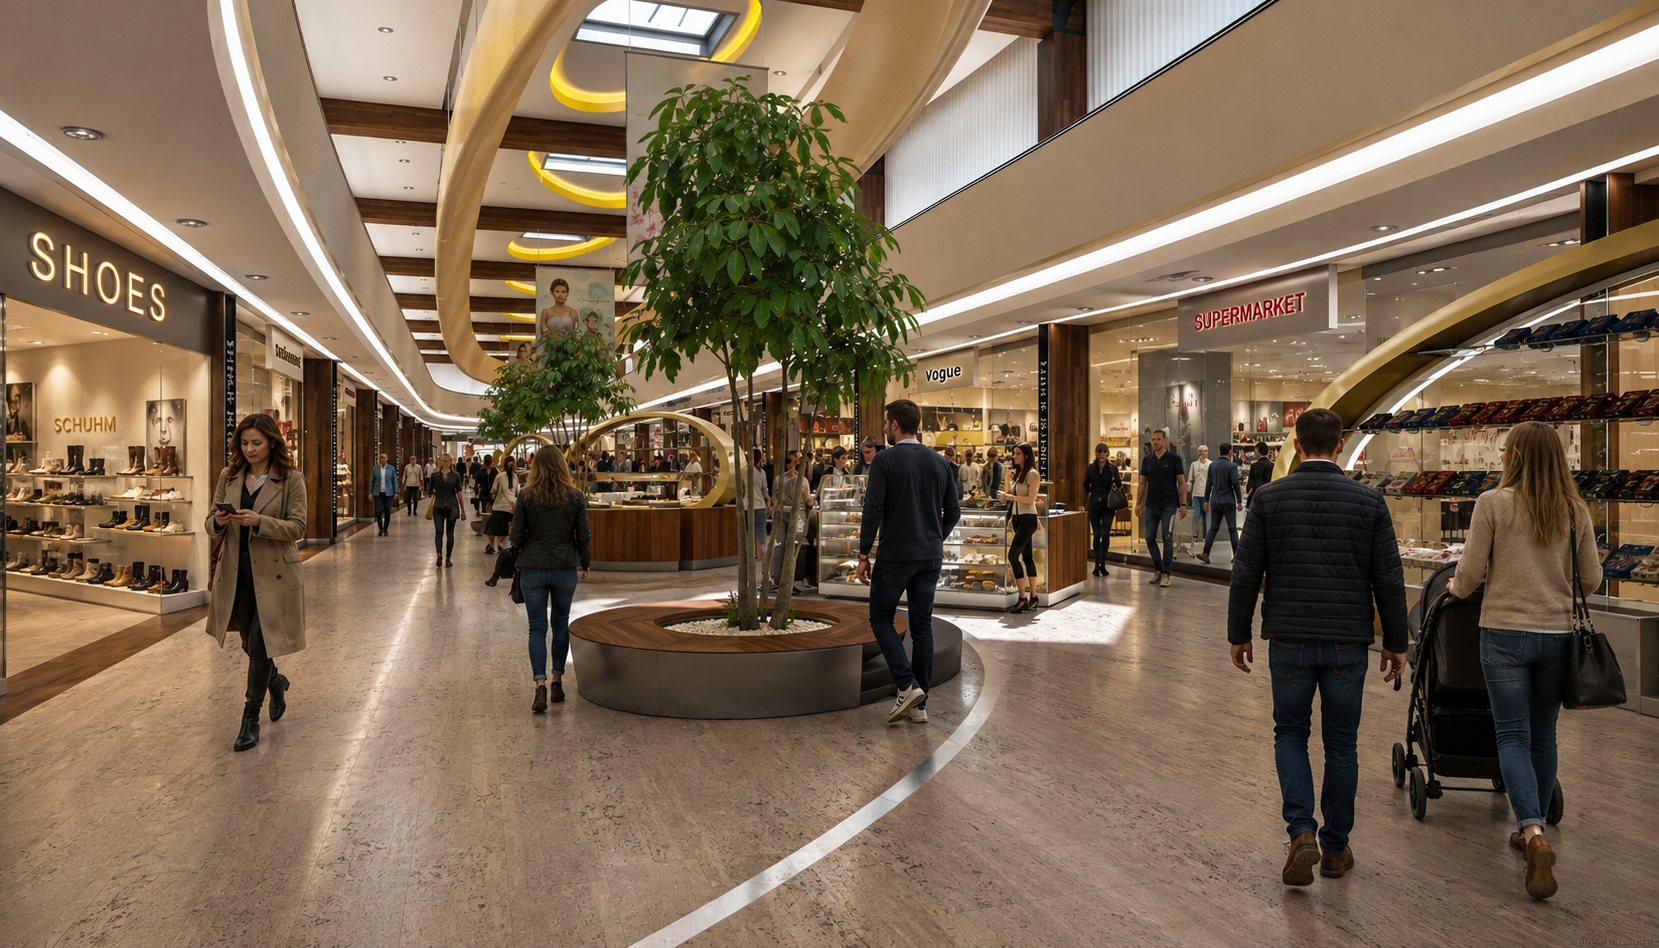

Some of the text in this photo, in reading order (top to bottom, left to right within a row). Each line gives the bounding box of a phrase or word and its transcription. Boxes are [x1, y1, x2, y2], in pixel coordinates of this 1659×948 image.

[29, 231, 166, 322] SHOES
[1194, 291, 1307, 332] SUPERMARKET
[925, 365, 962, 384] Vogue
[53, 416, 117, 433] SCHUHM
